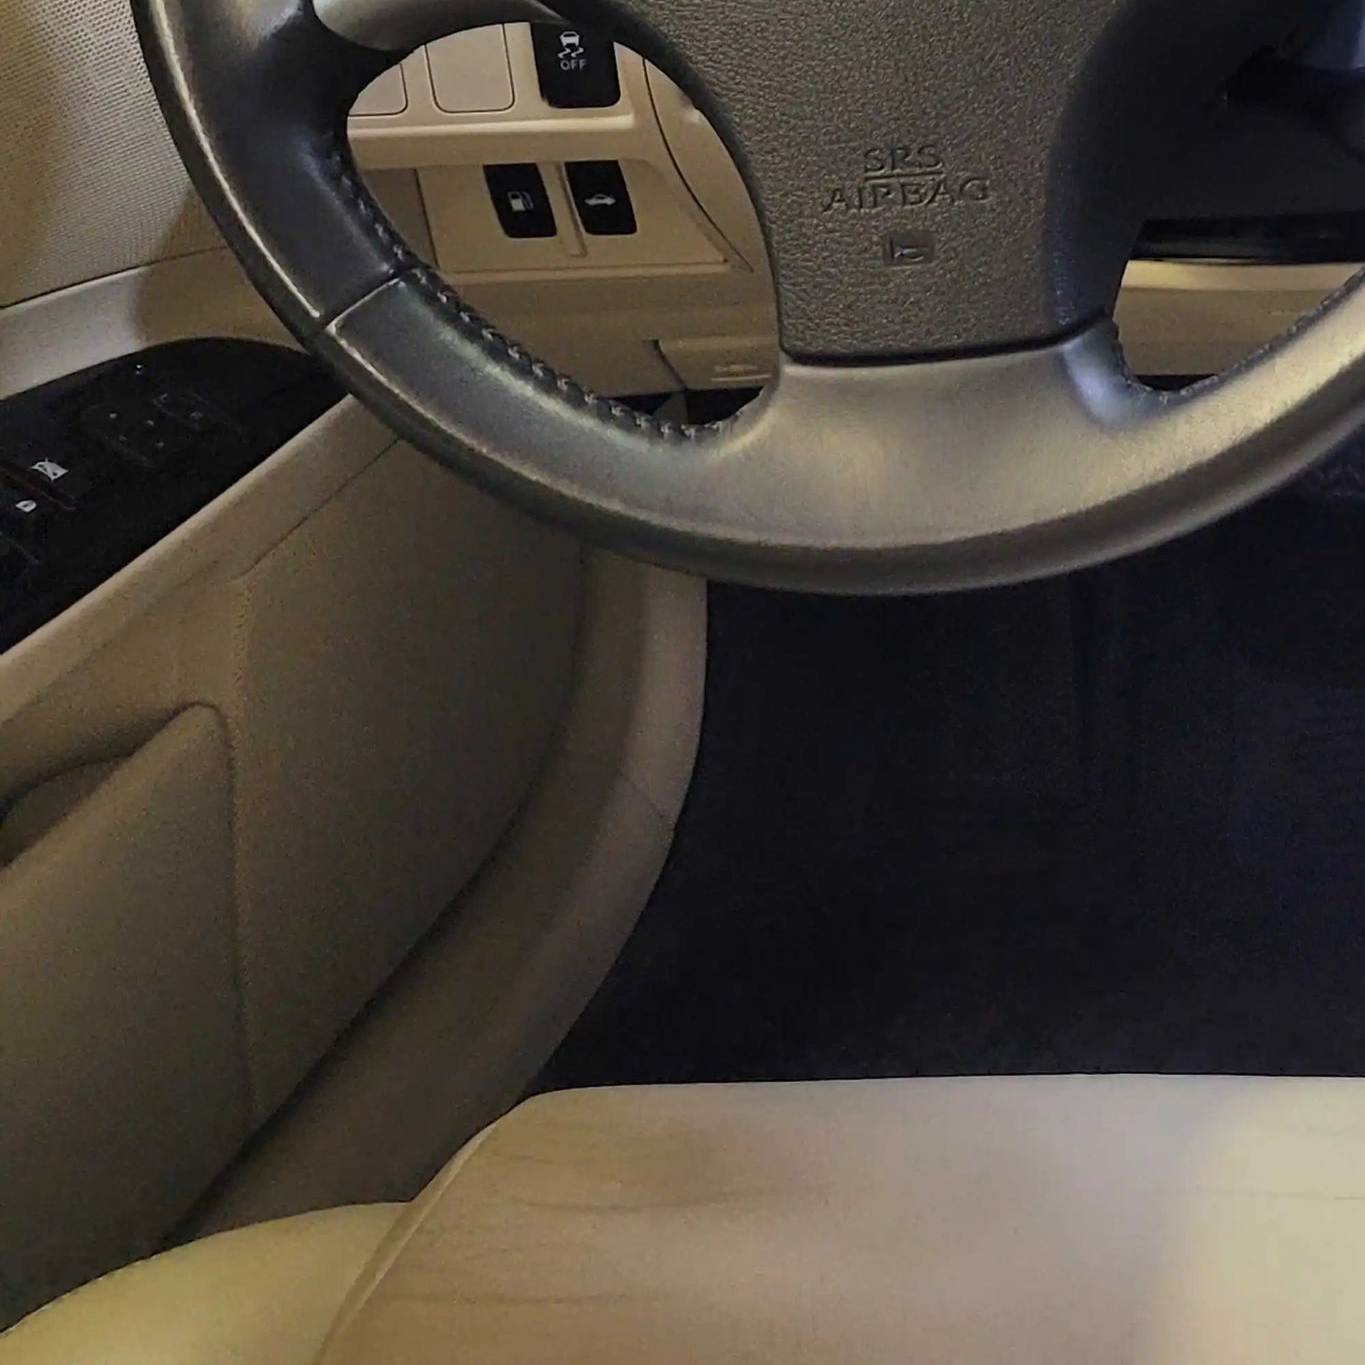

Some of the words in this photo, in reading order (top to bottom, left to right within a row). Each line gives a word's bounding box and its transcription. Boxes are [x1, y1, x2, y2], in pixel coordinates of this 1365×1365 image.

[560, 59, 588, 71] OFF
[864, 143, 945, 174] SRS
[821, 175, 992, 213] AIRBAG
